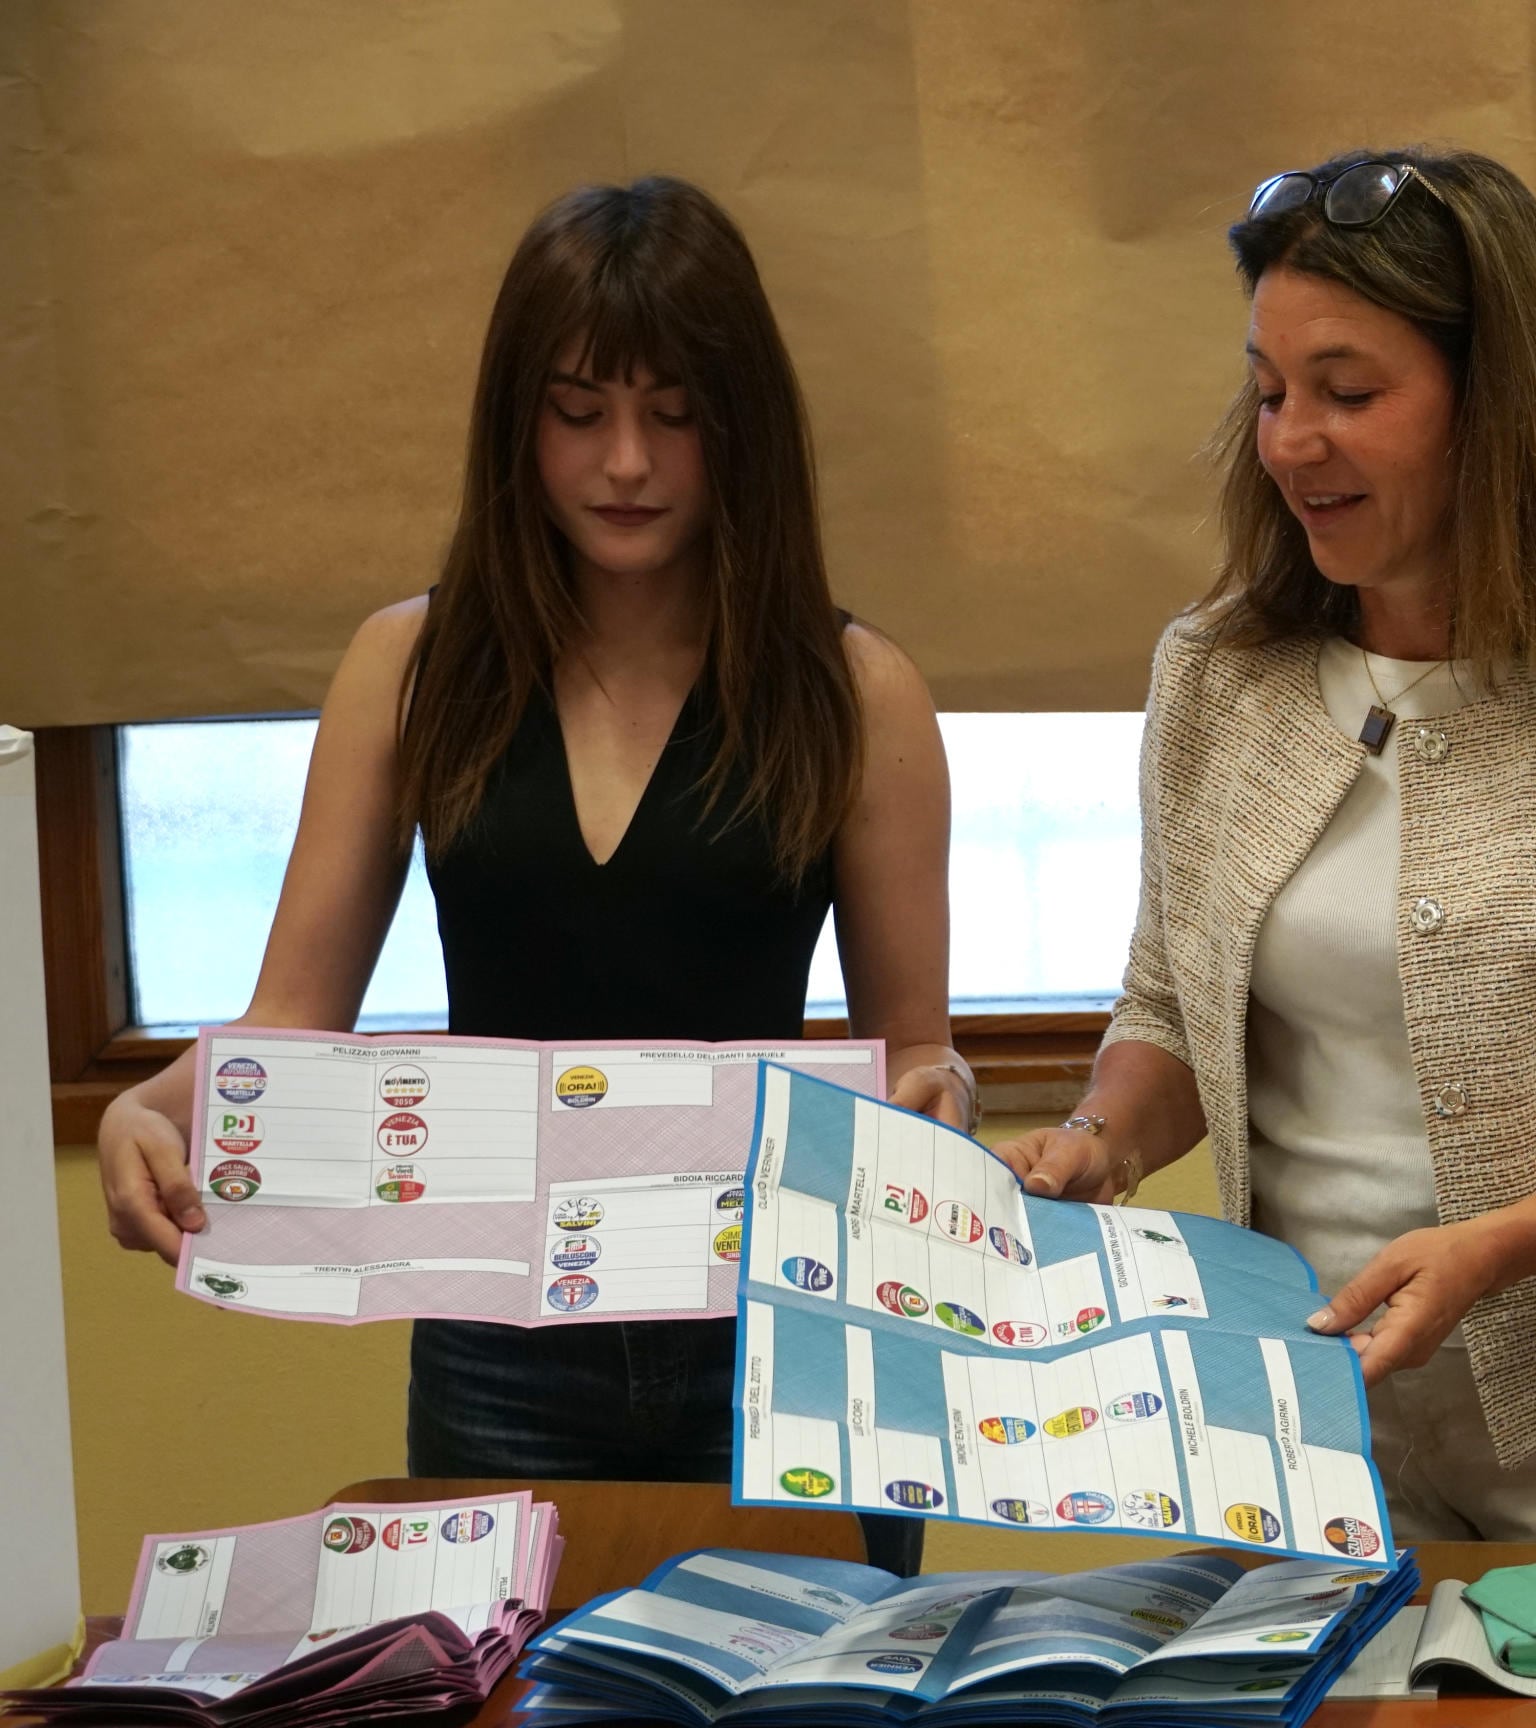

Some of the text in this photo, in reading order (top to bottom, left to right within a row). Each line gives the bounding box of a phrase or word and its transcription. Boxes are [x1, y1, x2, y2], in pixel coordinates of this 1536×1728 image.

[333, 1046, 377, 1057] PELIZZATO
[380, 1047, 421, 1057] GIOVANNI
[640, 1051, 695, 1059] PREVEDELLO
[746, 1051, 786, 1059] SAMUELE
[385, 1076, 426, 1086] MOVIMENTO
[567, 1082, 596, 1091] ORA!
[394, 1098, 414, 1106] 2050
[385, 1115, 419, 1127] VENEZIA
[386, 1133, 418, 1146] È TUA
[760, 1137, 775, 1180] VERNIER
[673, 1173, 743, 1183] BIDOIA RICCARD
[850, 1167, 866, 1217] MARTELLA
[559, 1198, 598, 1212] LEGA
[559, 1220, 596, 1228] SALVINI
[553, 1251, 596, 1261] BERLUSCONI
[314, 1265, 352, 1273] TRENTIN
[353, 1260, 412, 1273] ALESSANDRA
[796, 1258, 806, 1286] VERNIER
[556, 1278, 590, 1286] VENEZIA
[1114, 1262, 1129, 1288] GIOVANNI
[1019, 1326, 1033, 1338] TUA
[751, 1356, 762, 1383] ZOTTO
[749, 1384, 760, 1404] DEL
[1178, 1388, 1199, 1456] MICHELE BOLDRIN
[1278, 1398, 1298, 1471] ROBERTO AGIRMO
[1124, 1493, 1145, 1523] LEGA
[1160, 1495, 1173, 1525] SALVINI
[1247, 1512, 1259, 1534] ORA!
[1343, 1517, 1361, 1557] SZUMSKI
[499, 1576, 508, 1600] PELIZZA
[206, 1610, 218, 1633] TRENTIN
[870, 1663, 916, 1672] VERNIER
